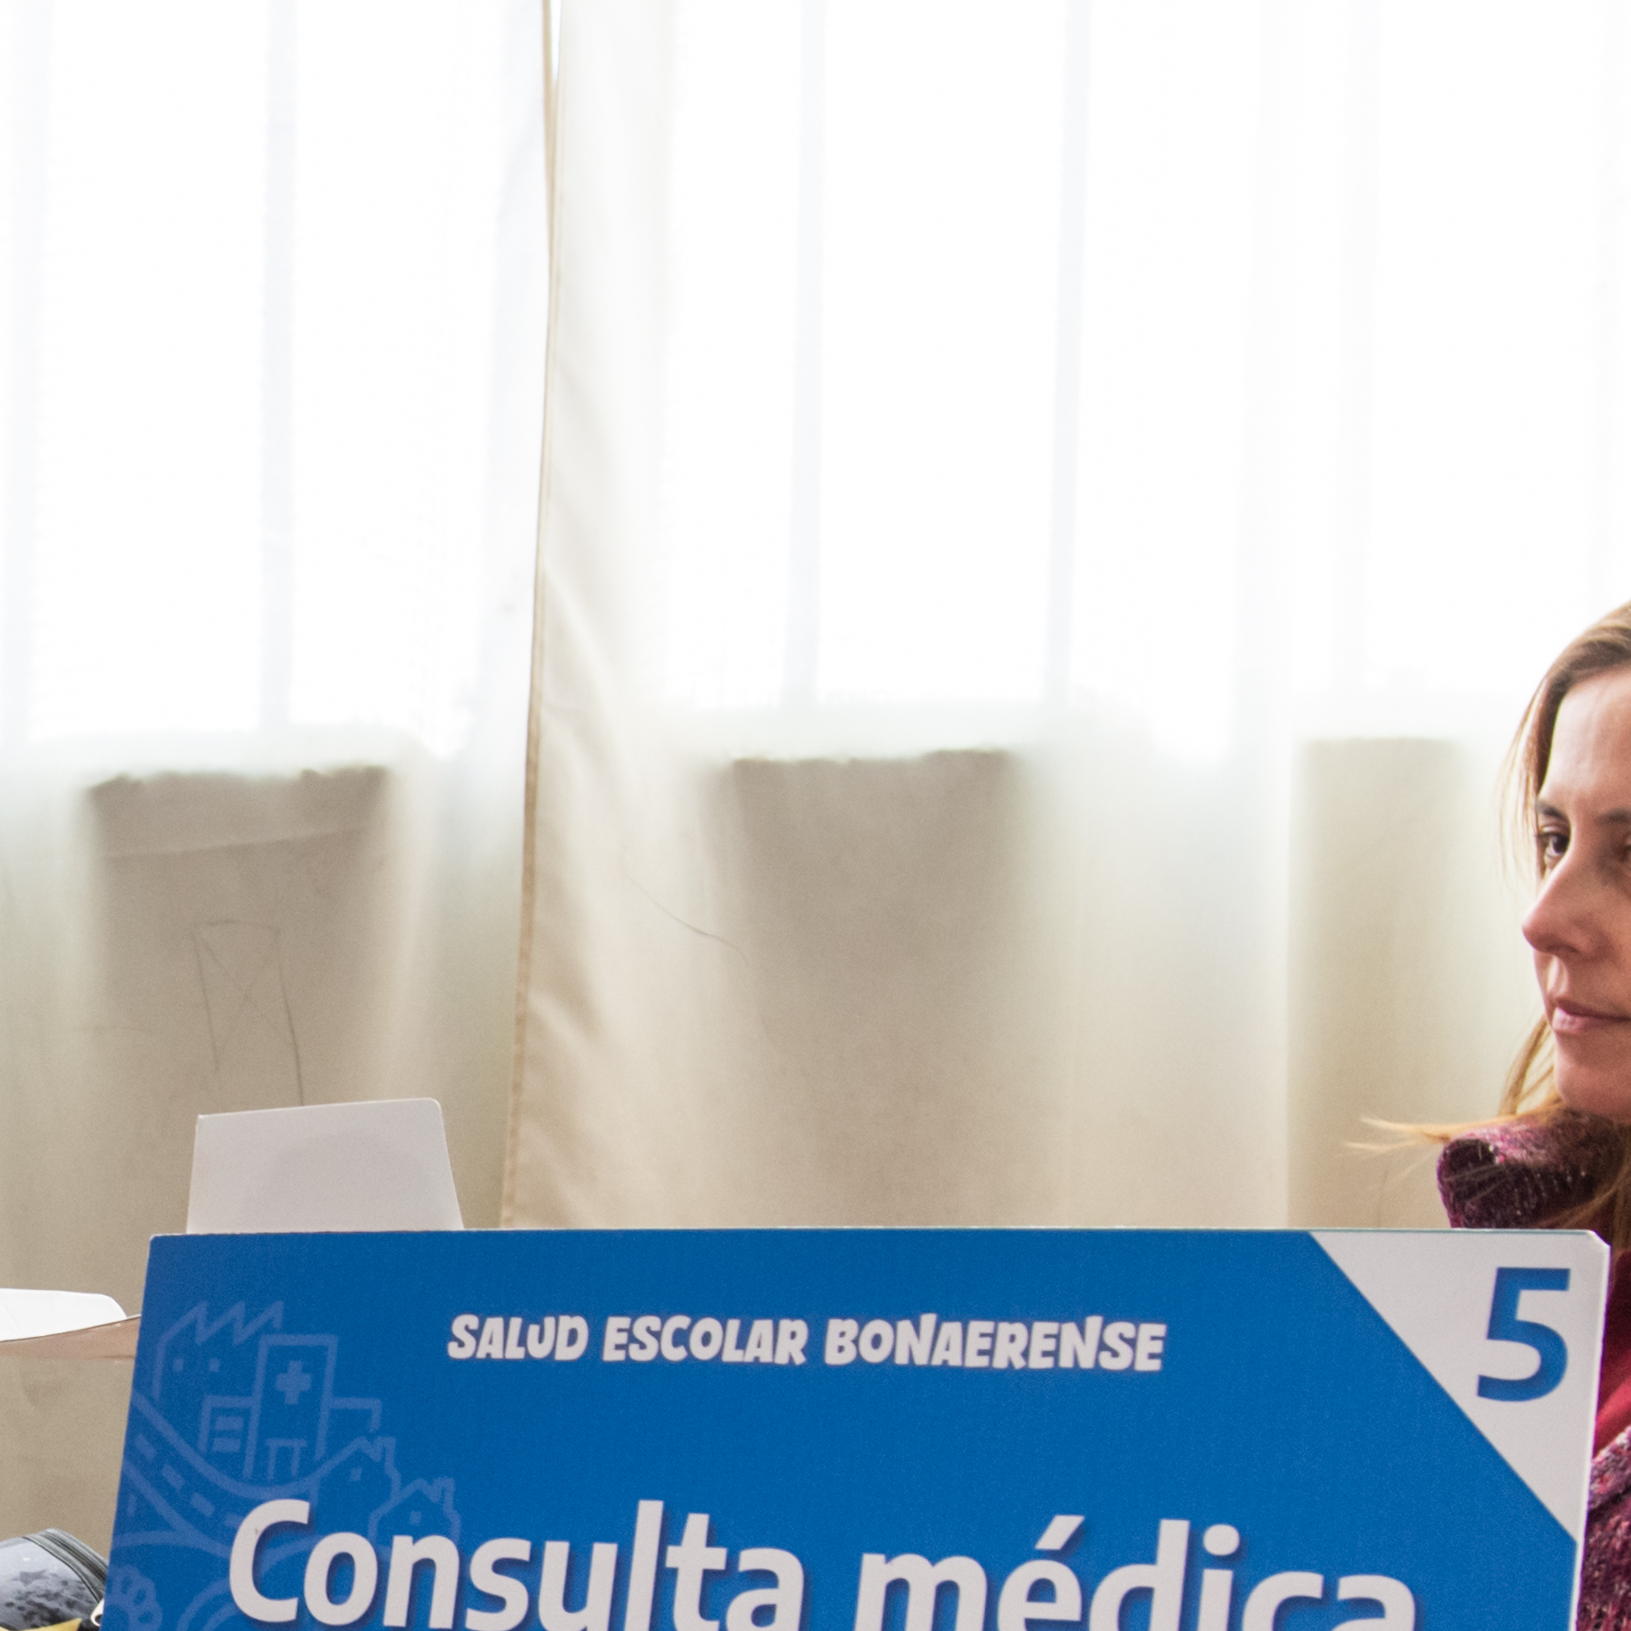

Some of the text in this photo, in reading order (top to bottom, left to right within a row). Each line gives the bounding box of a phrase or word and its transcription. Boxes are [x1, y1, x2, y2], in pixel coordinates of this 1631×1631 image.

[446, 1312, 1168, 1374] SALUD ESCOLAR BONAERENSE
[1477, 1267, 1570, 1402] 5
